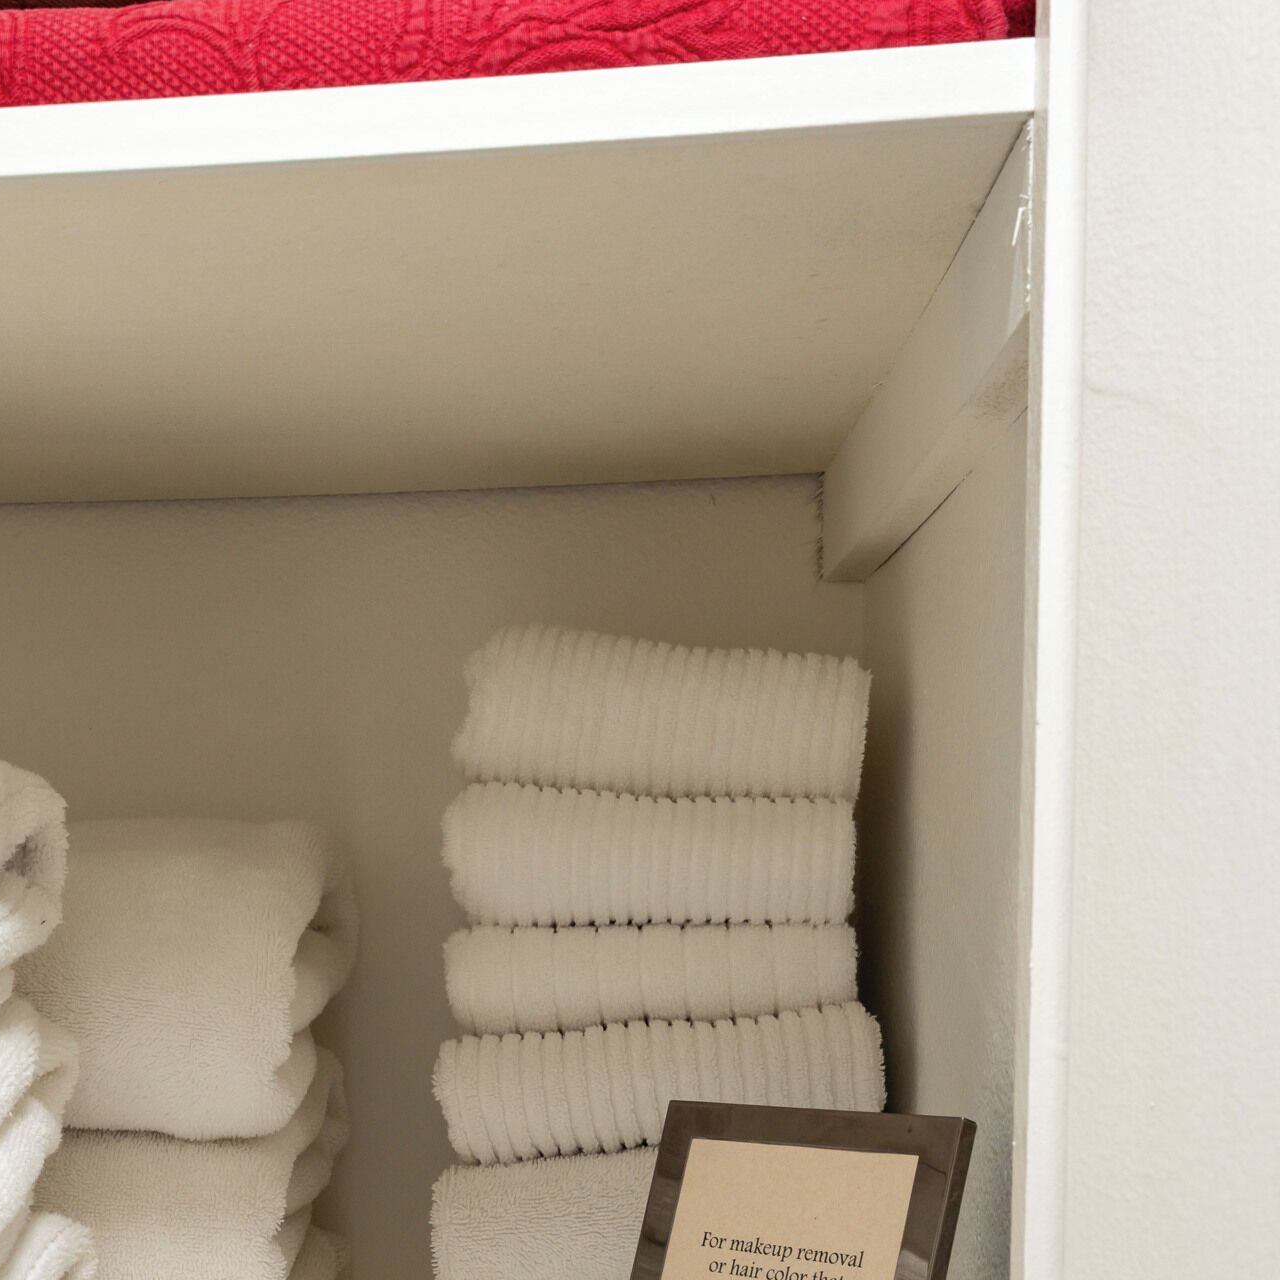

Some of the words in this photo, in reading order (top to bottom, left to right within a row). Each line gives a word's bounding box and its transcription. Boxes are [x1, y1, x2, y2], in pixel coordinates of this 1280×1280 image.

[700, 1231, 728, 1250] For
[729, 1237, 793, 1263] makeup
[796, 1247, 865, 1269] removal
[708, 1260, 727, 1274] or
[729, 1258, 763, 1279] hair
